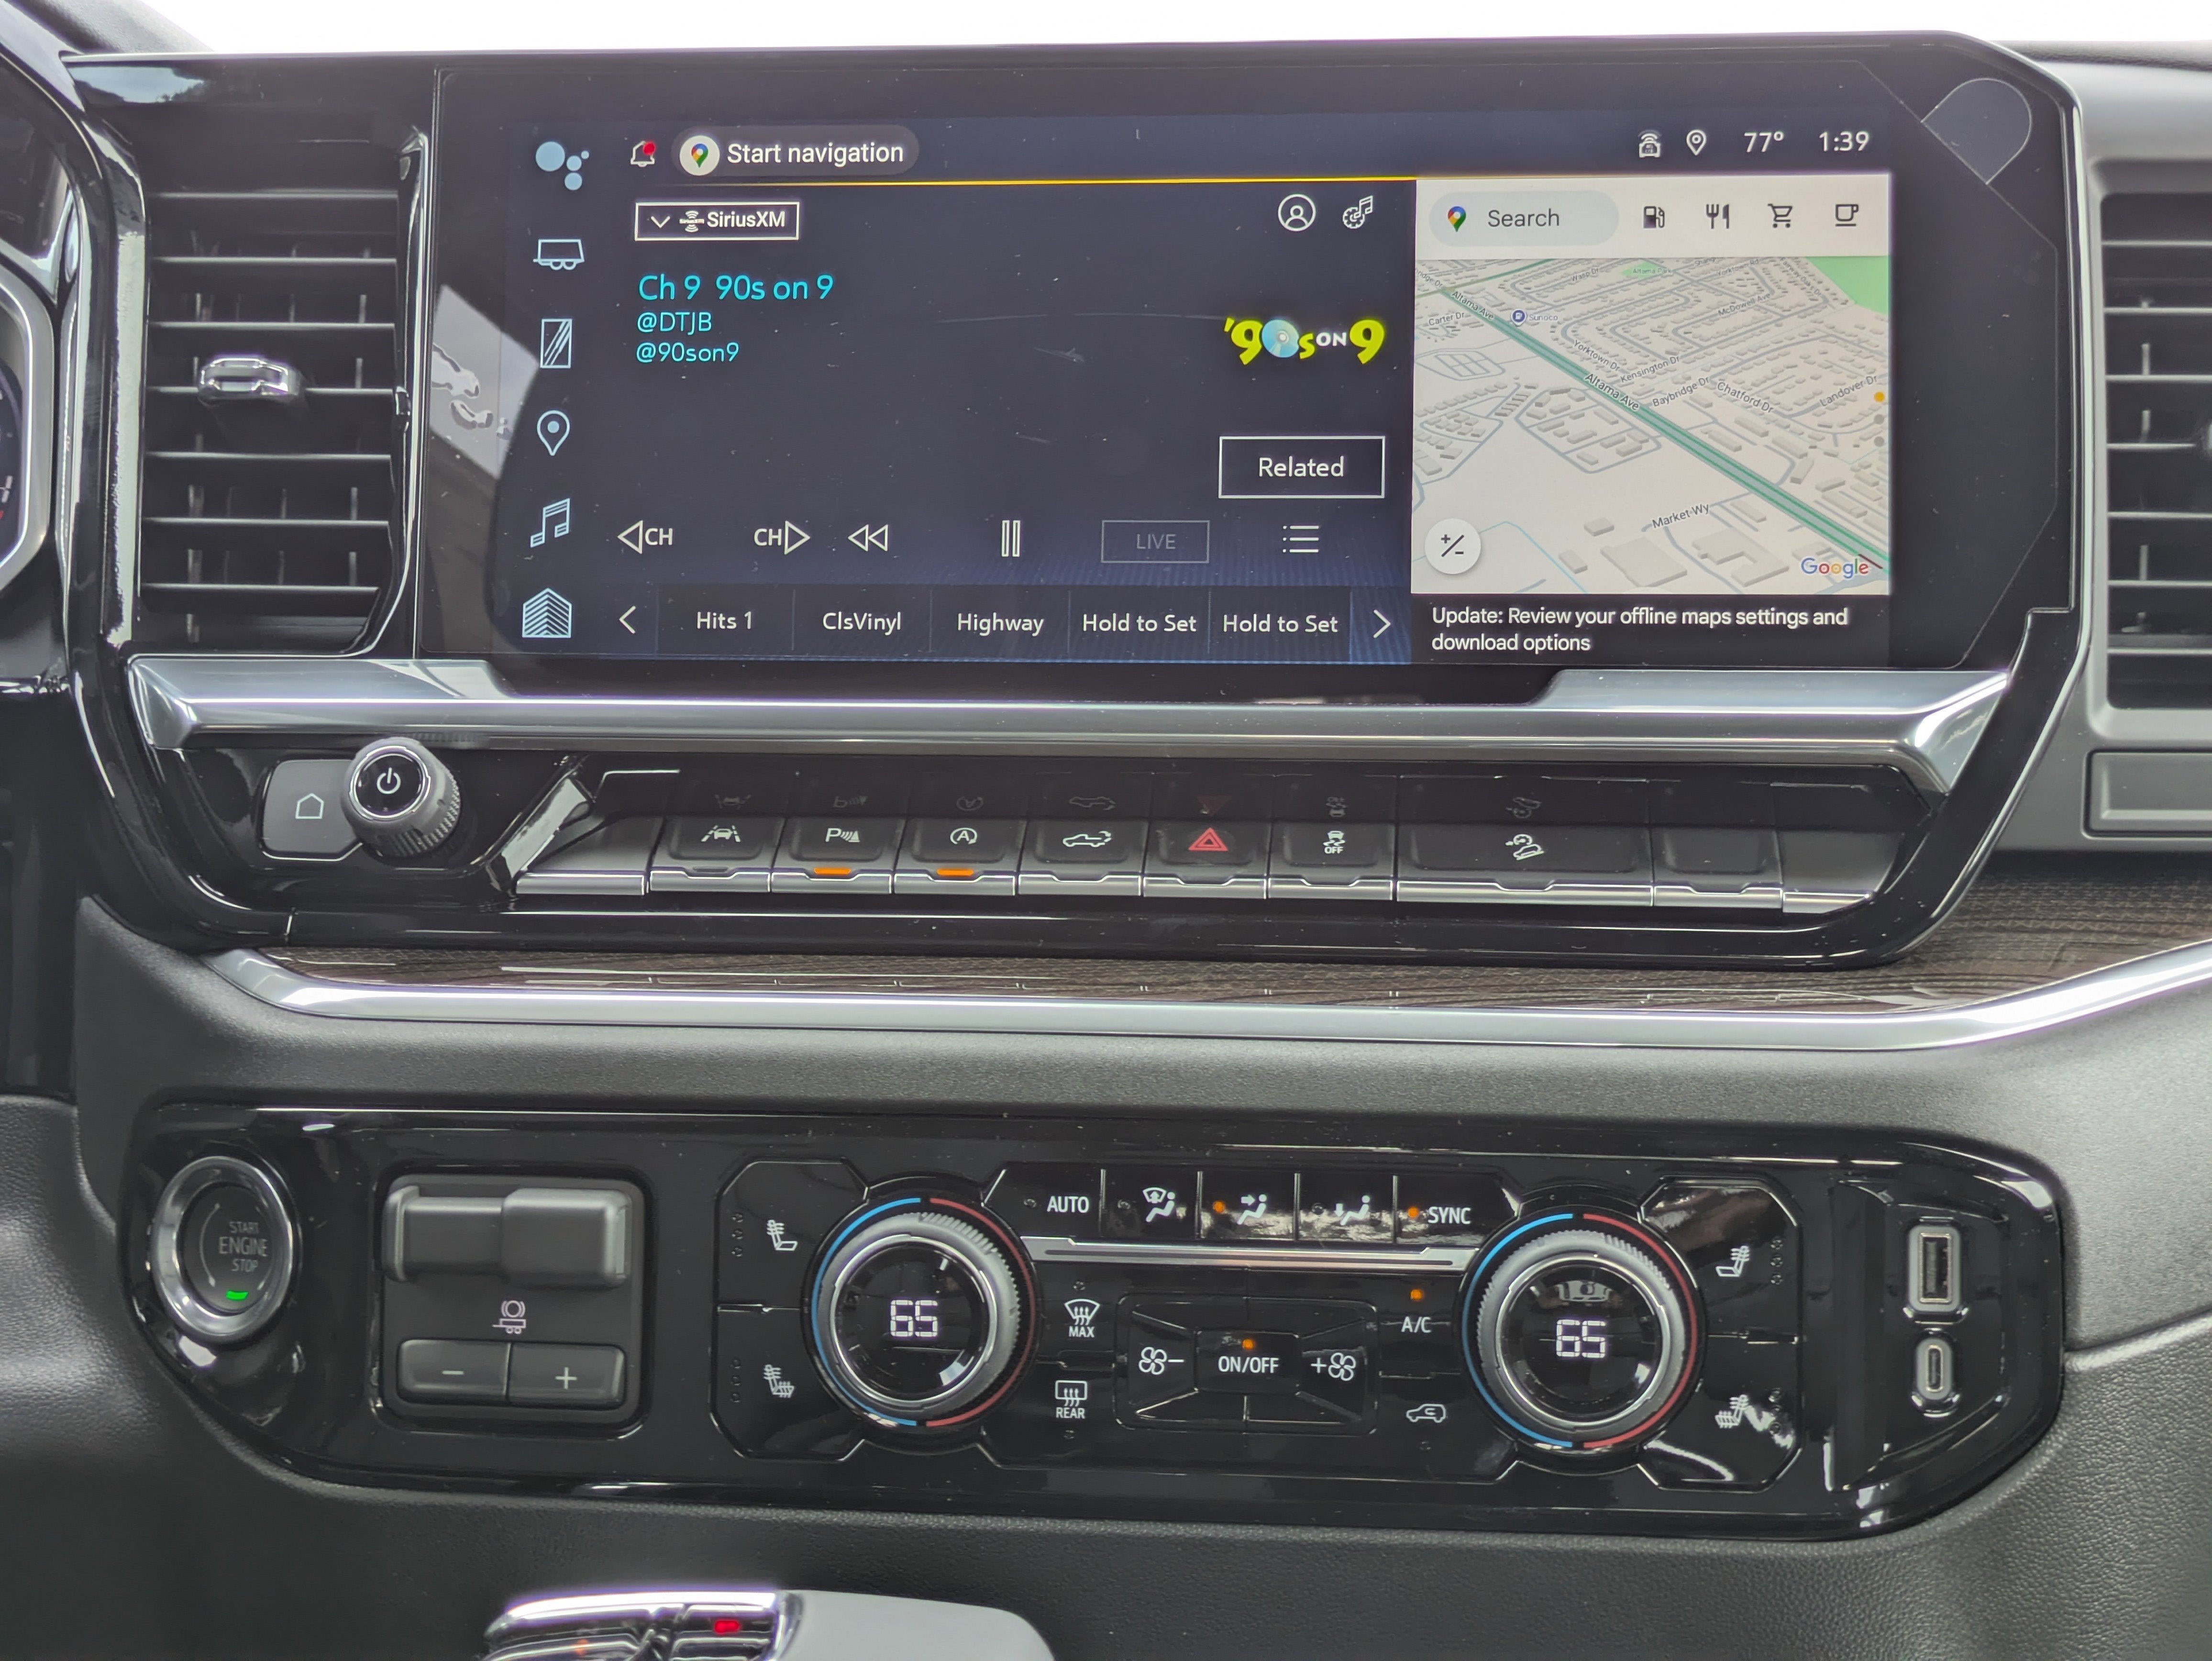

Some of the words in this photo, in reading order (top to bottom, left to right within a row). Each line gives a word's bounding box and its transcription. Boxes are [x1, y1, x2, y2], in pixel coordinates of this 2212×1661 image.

[1819, 131, 1869, 151] 1:39
[728, 143, 781, 164] Start
[788, 142, 903, 167] navigation
[707, 211, 785, 227] SiriusXM
[1487, 209, 1560, 228] Search
[639, 273, 675, 300] Ch
[684, 275, 701, 299] 9
[716, 275, 765, 300] 90s
[773, 281, 808, 299] on
[817, 275, 833, 299] 9
[1451, 291, 1479, 311] Altama
[1480, 308, 1494, 320] Ave
[1717, 298, 1756, 317] McDowell
[1757, 293, 1771, 302] Ave
[637, 312, 712, 335] @DTJB
[1428, 315, 1453, 326] Carter
[1529, 313, 1559, 321] Sunoco
[636, 342, 740, 363] @90son9
[1316, 332, 1347, 347] ON
[1349, 319, 1385, 365] 9
[1573, 340, 1609, 366] Yorktown
[1610, 362, 1620, 372] Dr
[1620, 360, 1669, 383] Kensington
[1669, 356, 1680, 365] Dr
[1584, 373, 1620, 399] Altama
[1620, 395, 1640, 411] Ave
[1652, 382, 1699, 407] Baybridge
[1698, 376, 1710, 387] Dr
[1717, 381, 1761, 407] Chatford
[1760, 401, 1774, 414] Dr
[1820, 381, 1865, 407] Landover
[1866, 375, 1878, 386] Dr
[1259, 456, 1344, 477] Related
[1652, 510, 1690, 529] Market
[1691, 504, 1709, 515] Wy
[645, 528, 673, 545] CH
[754, 528, 782, 546] CH
[1136, 533, 1176, 550] LIVE
[1801, 557, 1869, 579] Google
[697, 611, 737, 630] Hits
[744, 611, 752, 630] 1
[823, 611, 901, 636] ClsVinyl
[958, 612, 1045, 636] Highway
[1083, 613, 1130, 632] Hold
[1136, 616, 1158, 632] to
[1163, 614, 1197, 632] Set
[1223, 613, 1271, 632] Hold
[1277, 616, 1299, 632] to
[1305, 614, 1338, 633] Set
[1432, 606, 1503, 628] Update:
[1508, 607, 1572, 624] Review
[1574, 611, 1616, 628] your
[1620, 607, 1677, 625] offline
[1681, 611, 1732, 629] maps
[1736, 607, 1809, 629] settings
[1813, 608, 1848, 625] and
[1432, 632, 1518, 651] download
[1523, 633, 1592, 654] options
[1047, 1196, 1089, 1213] AUTO
[1427, 1206, 1471, 1225] SYNC
[229, 1221, 259, 1234] START
[219, 1236, 268, 1257] ENGINE
[231, 1259, 258, 1272] STOP
[890, 1299, 938, 1338] 65
[1401, 1316, 1431, 1333] A/C
[1069, 1326, 1095, 1338] MAX
[1556, 1319, 1606, 1359] 65
[1218, 1356, 1279, 1373] ON/OFF
[1056, 1407, 1085, 1419] REAR
